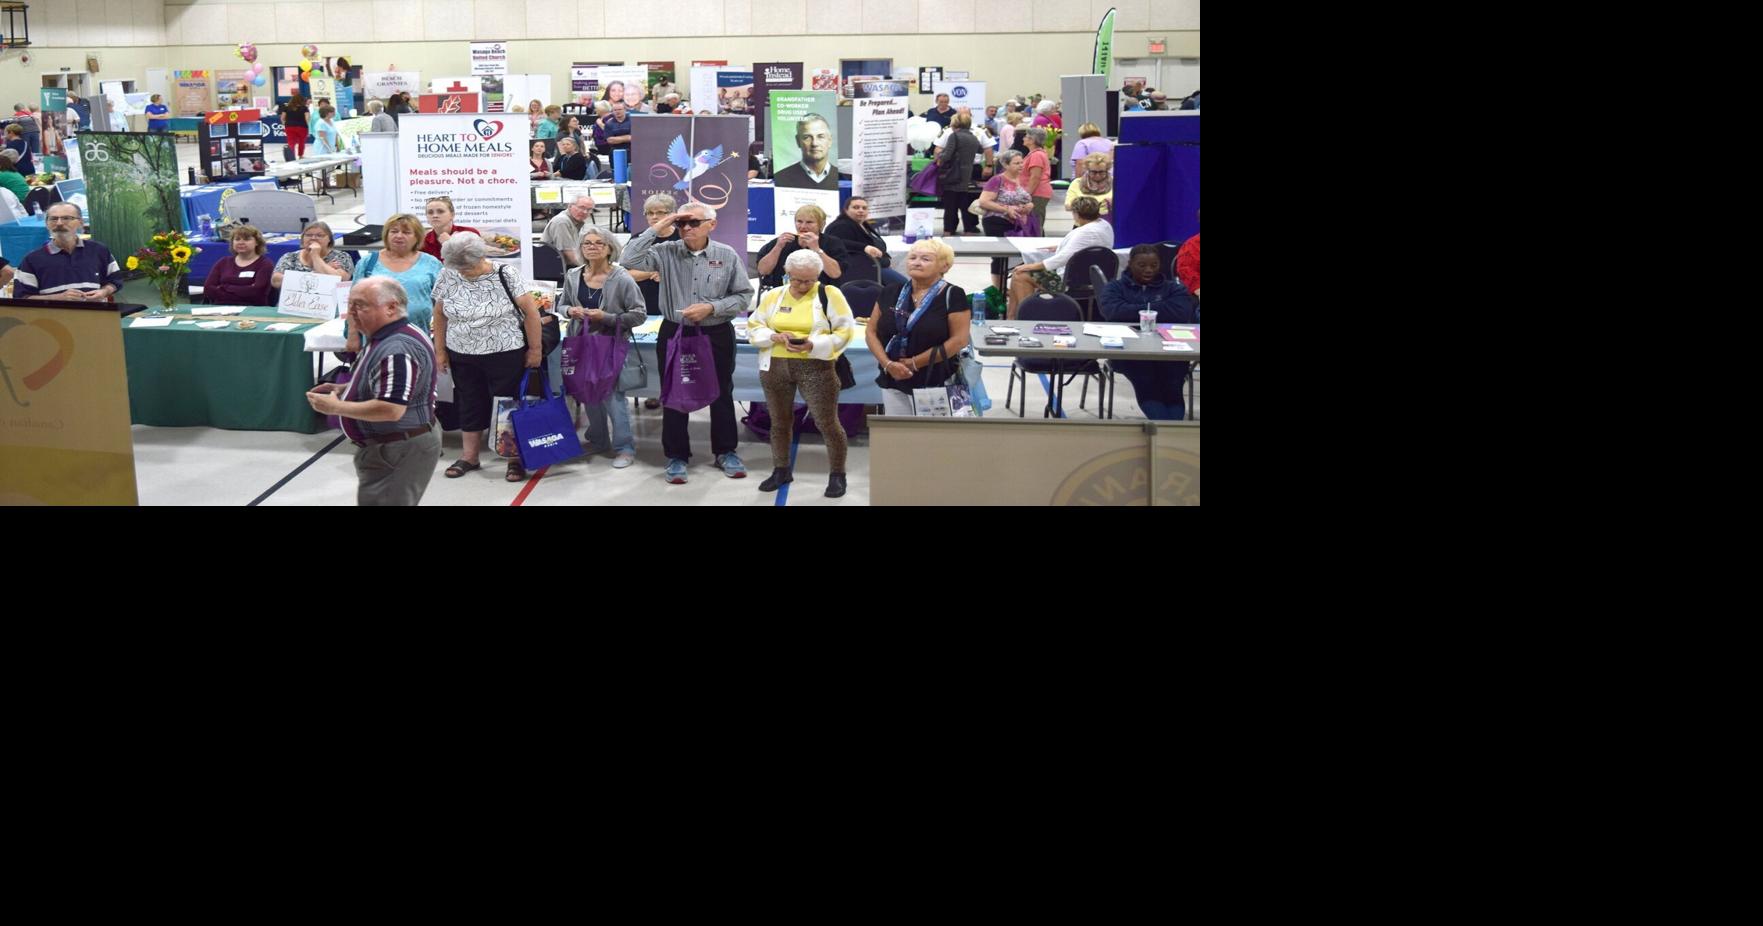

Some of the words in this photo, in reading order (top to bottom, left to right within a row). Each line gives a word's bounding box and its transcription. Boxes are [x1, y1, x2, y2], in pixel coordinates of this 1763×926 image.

[417, 133, 456, 142] HEART
[459, 133, 477, 142] TO
[417, 143, 461, 153] HOME
[464, 142, 513, 152] MEALS
[409, 168, 438, 176] Meals
[409, 178, 454, 186] pleasure.
